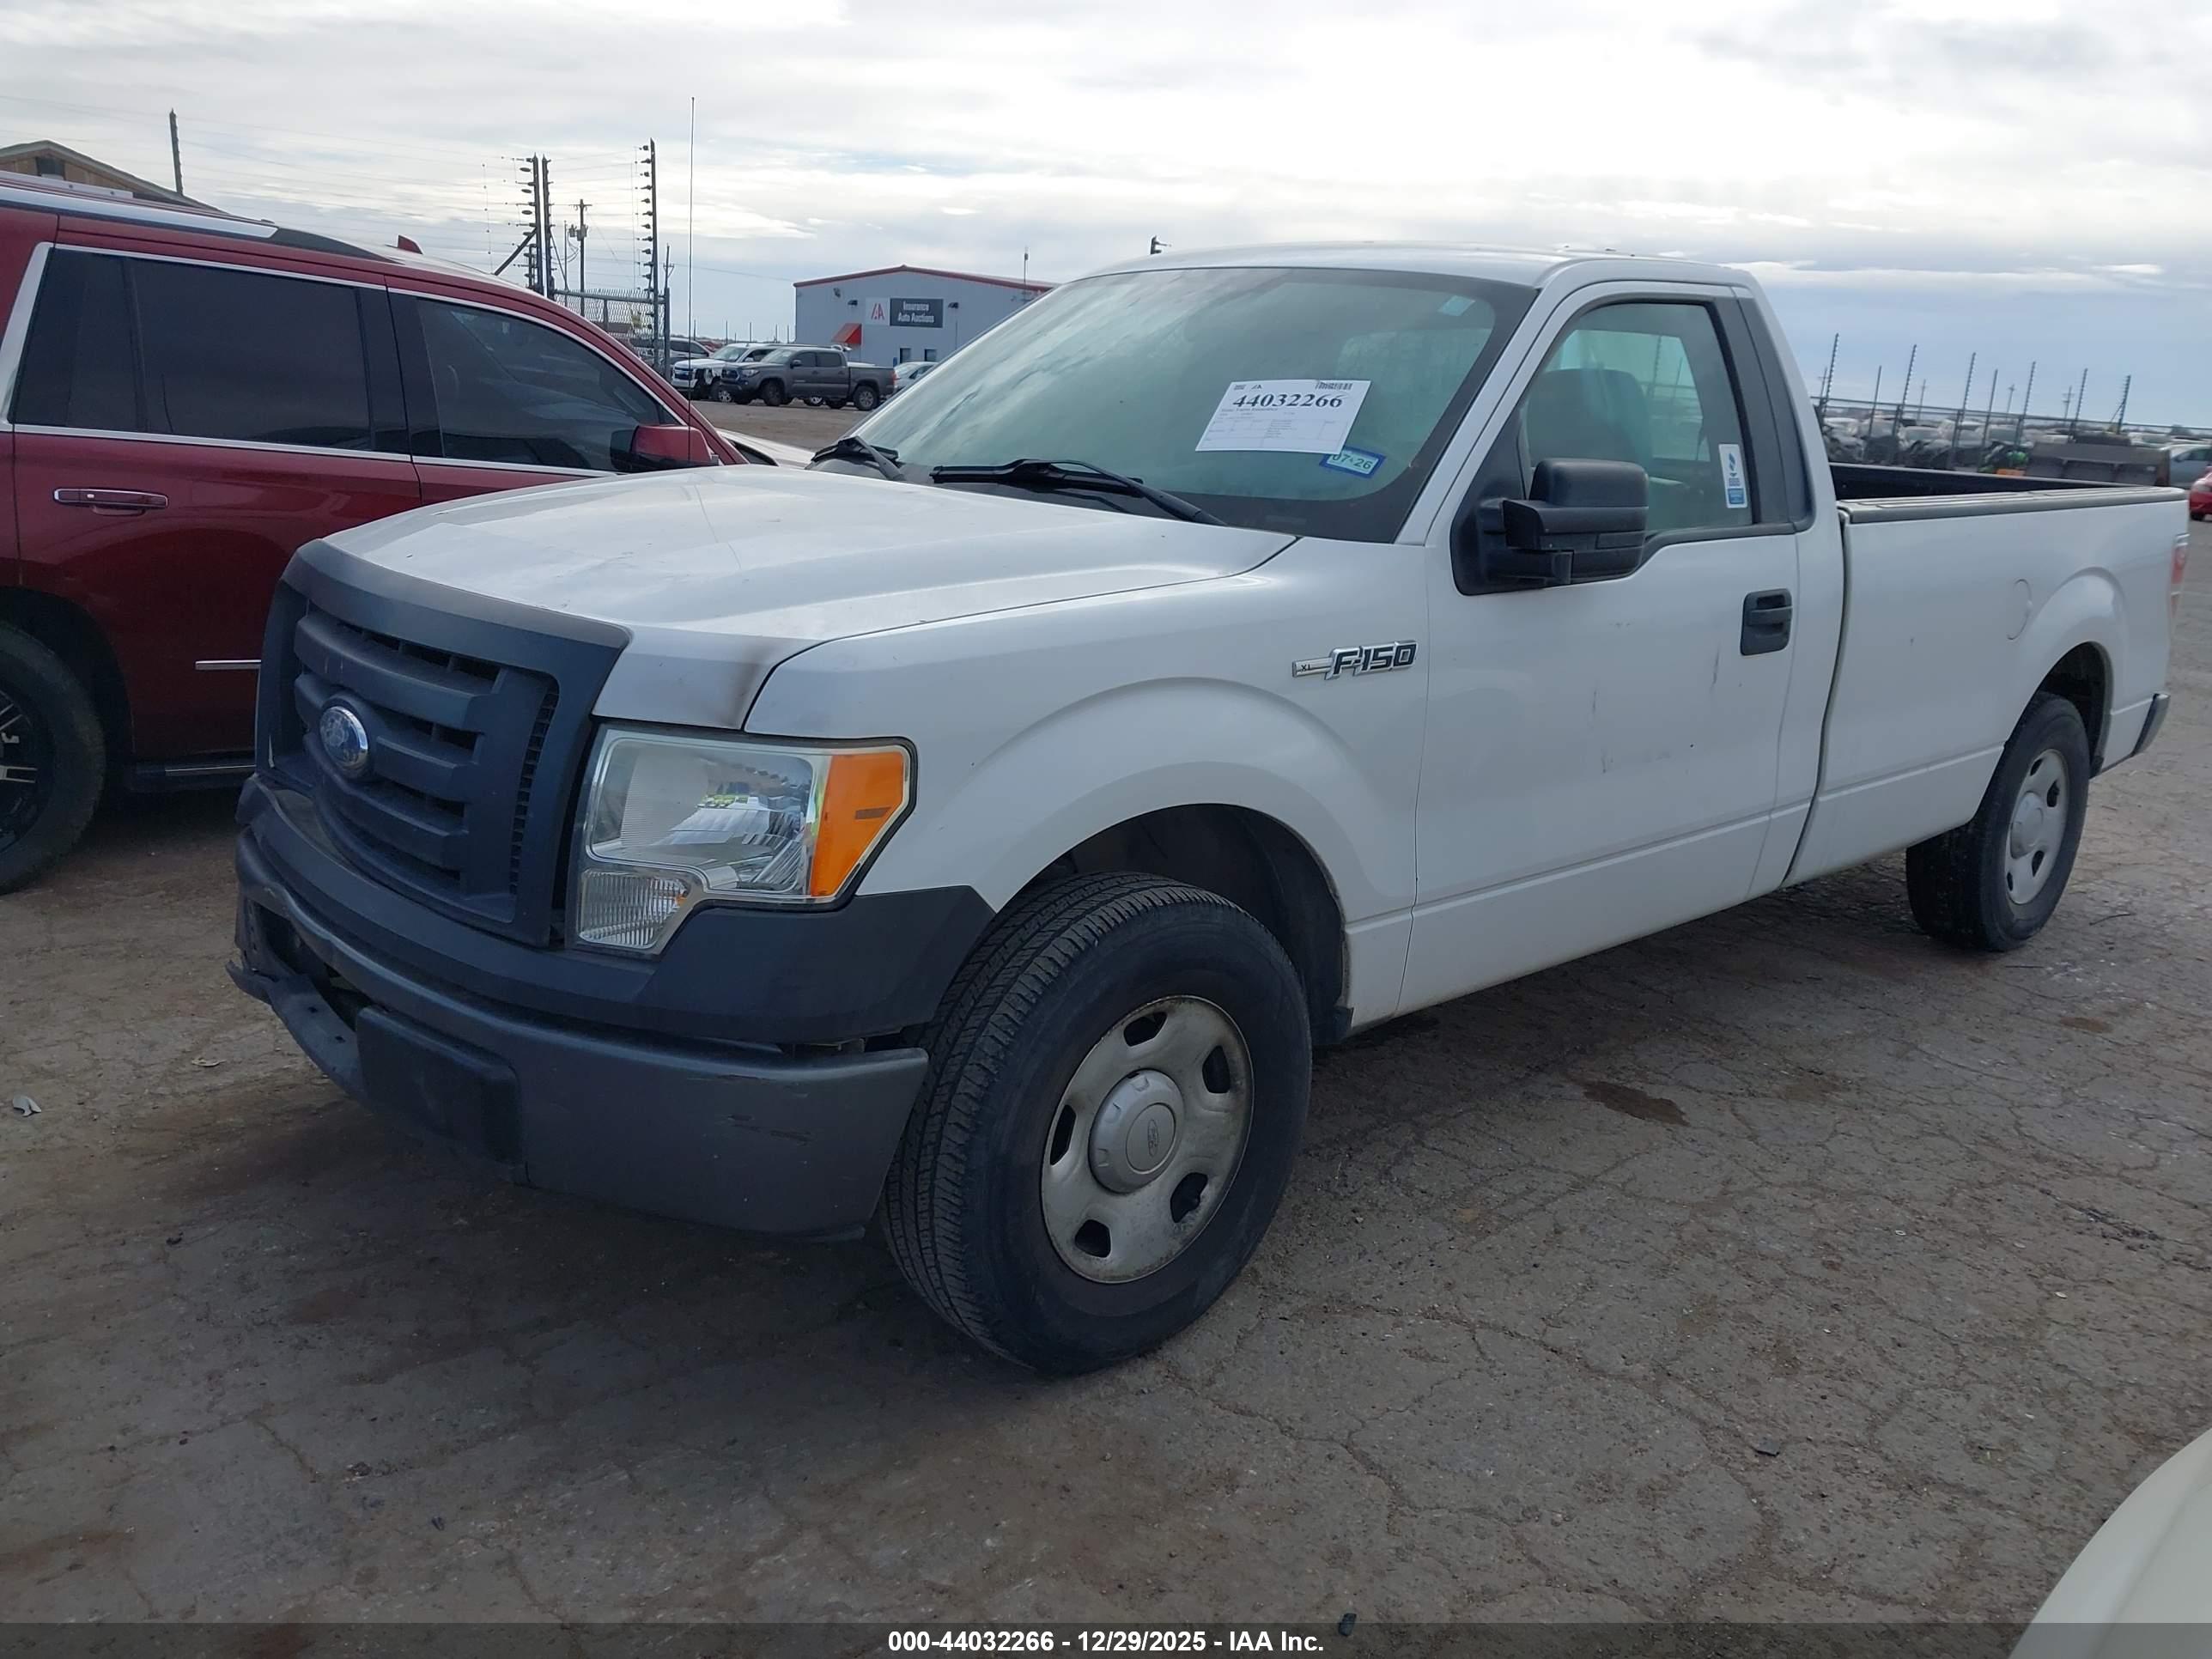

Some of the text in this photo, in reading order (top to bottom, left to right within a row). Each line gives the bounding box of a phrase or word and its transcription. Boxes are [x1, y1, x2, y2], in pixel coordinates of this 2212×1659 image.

[1232, 393, 1344, 408] 44032266
[1353, 458, 1374, 470] 26
[1325, 641, 1418, 680] F-150
